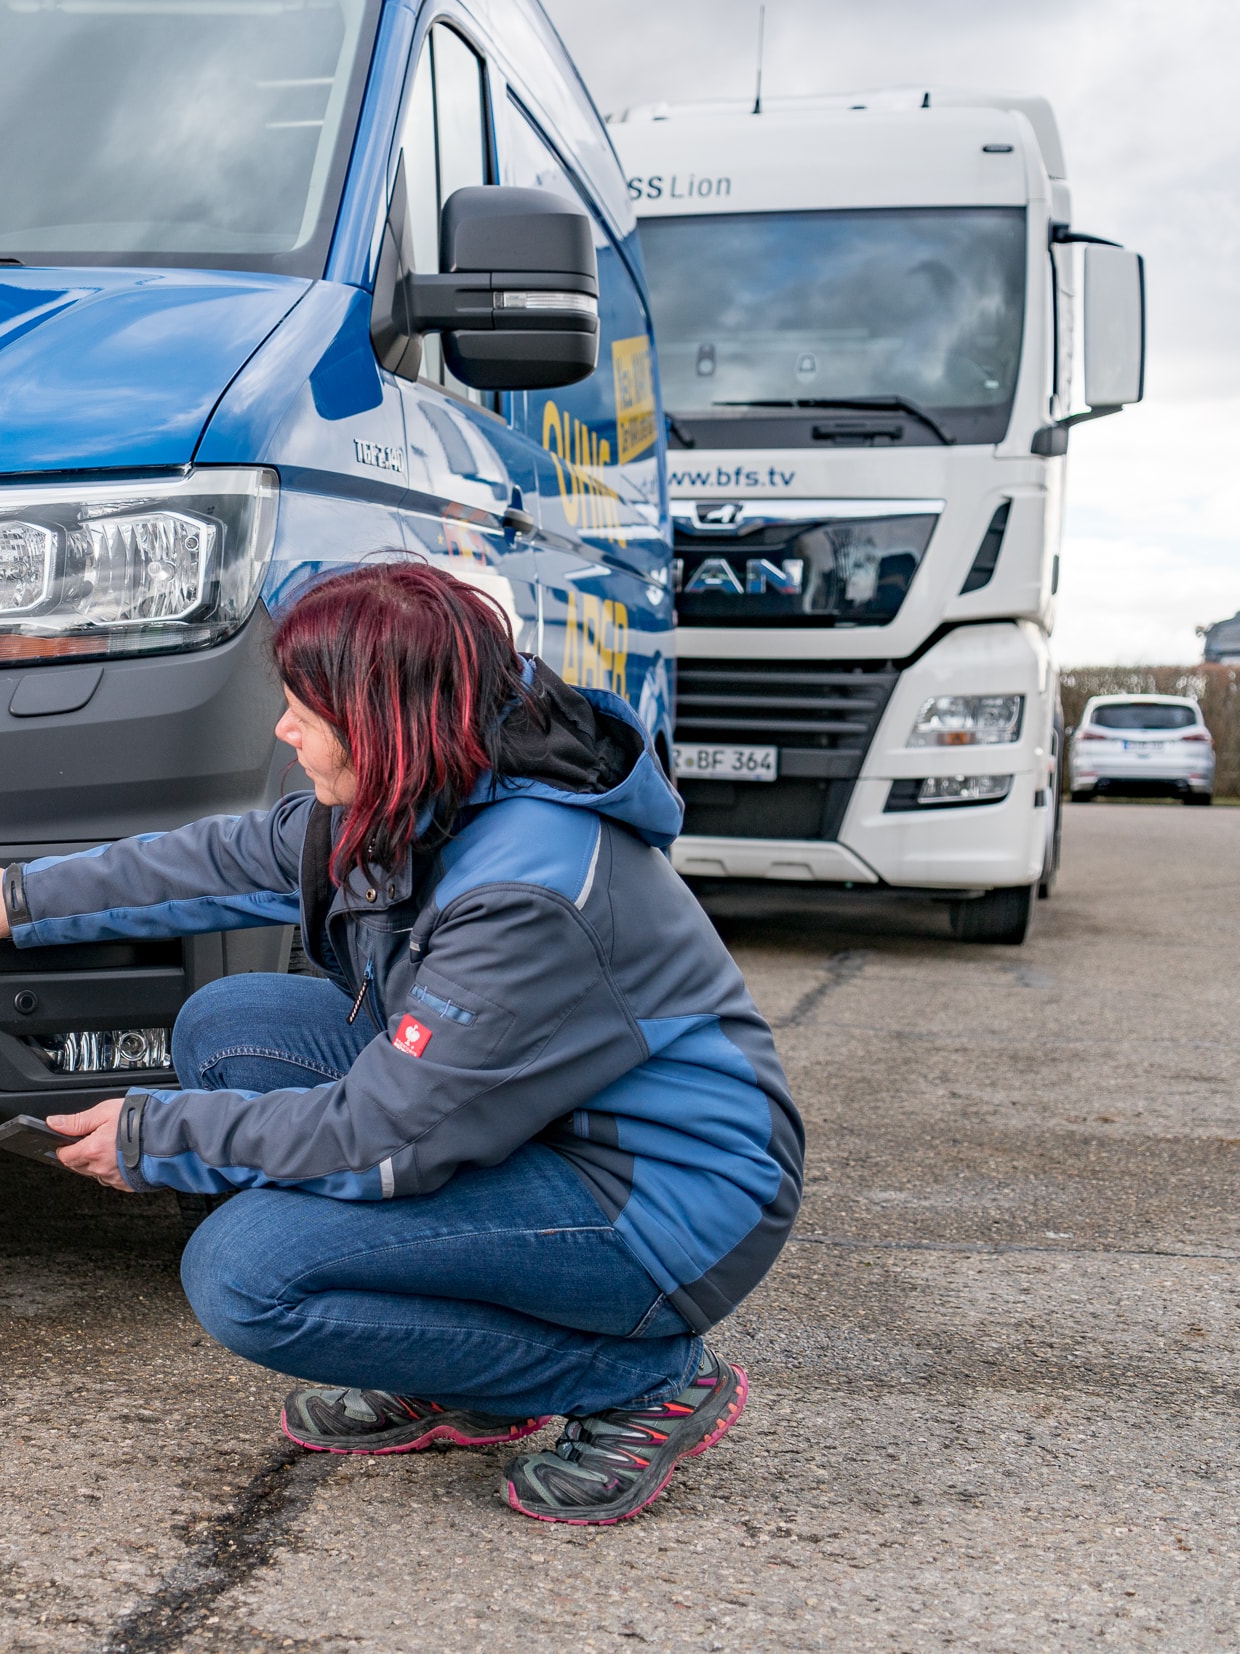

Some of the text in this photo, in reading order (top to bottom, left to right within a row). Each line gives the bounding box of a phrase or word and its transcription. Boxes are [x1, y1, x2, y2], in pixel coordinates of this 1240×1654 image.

[667, 466, 796, 487] ww.bfs.tv
[671, 557, 804, 594] AN
[697, 750, 726, 770] BF
[731, 751, 773, 771] 364
